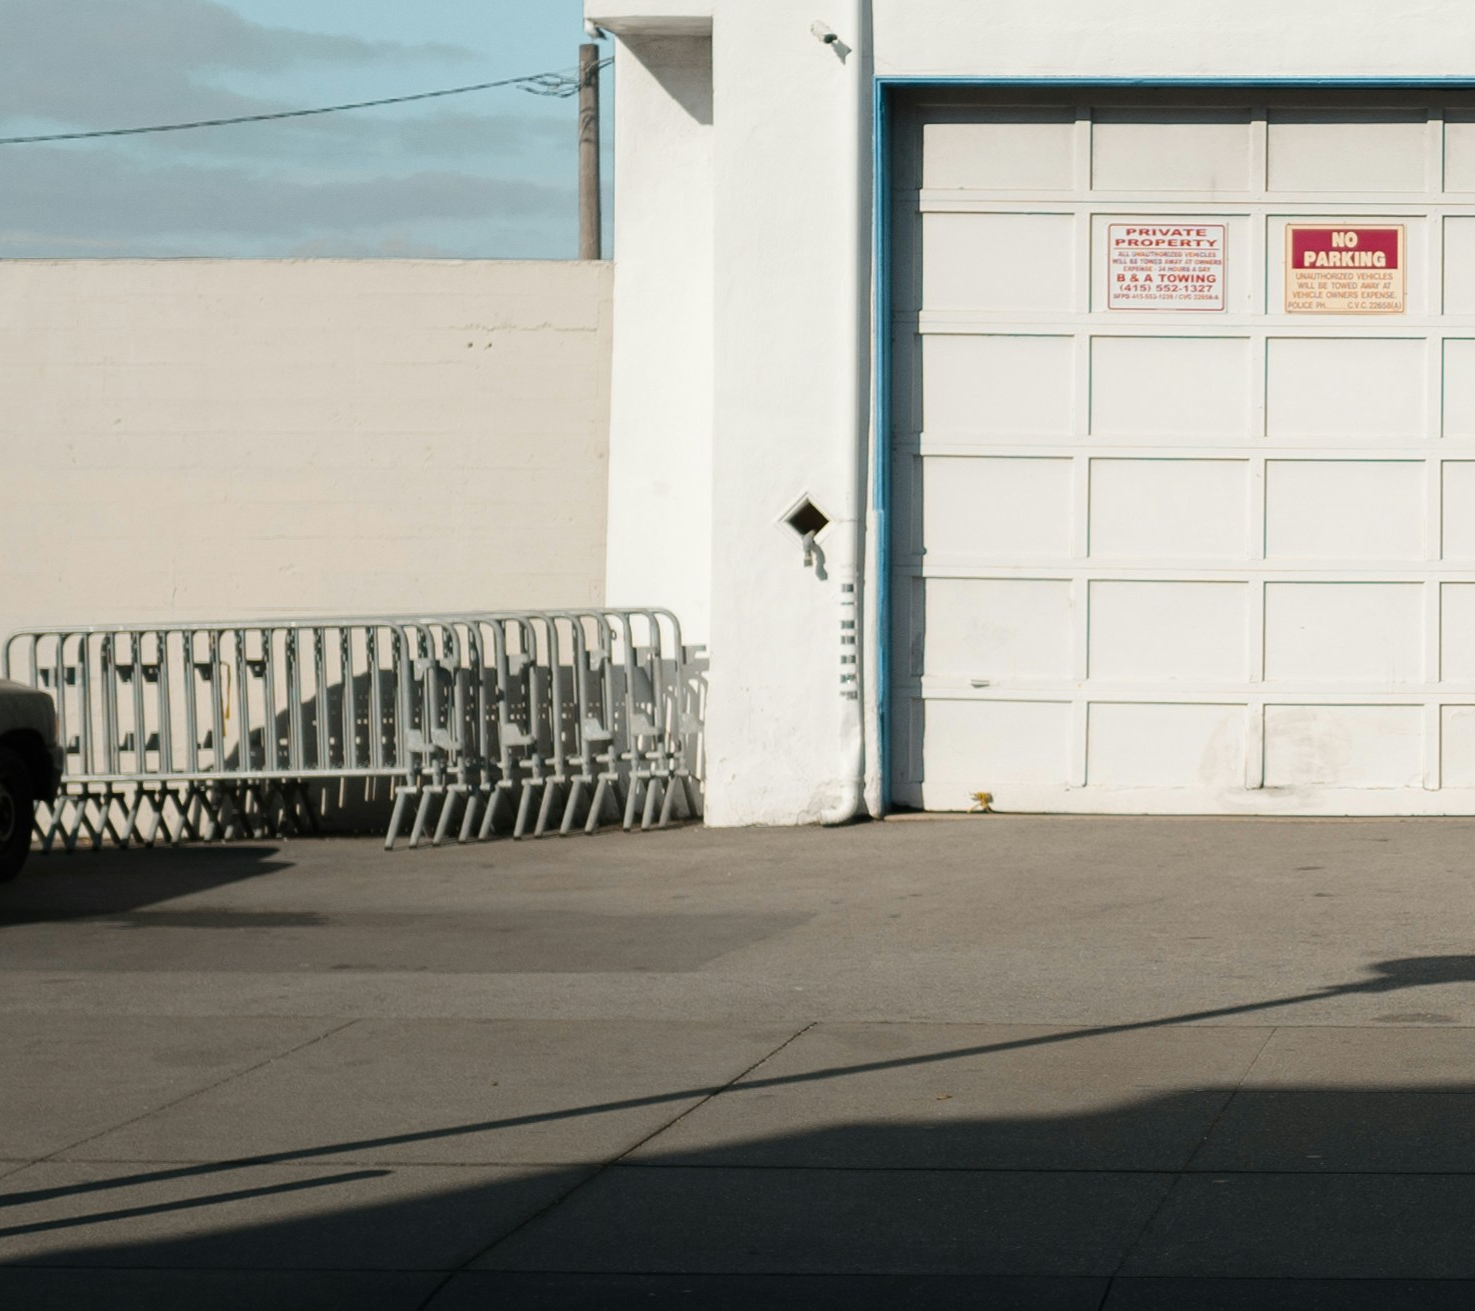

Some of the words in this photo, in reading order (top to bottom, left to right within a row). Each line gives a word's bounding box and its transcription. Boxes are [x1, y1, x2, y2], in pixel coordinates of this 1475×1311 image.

[1126, 228, 1207, 236] PRIVATE
[1114, 238, 1218, 247] PROPERTY
[1331, 231, 1358, 248] NO
[1304, 250, 1386, 268] PARKING
[1116, 274, 1126, 283] B
[1130, 274, 1139, 283] &
[1144, 274, 1153, 283] A
[1158, 274, 1216, 283] TOWING
[1295, 272, 1354, 280] UNAUTHORIZED
[1356, 272, 1394, 280] VEHICLES
[1119, 284, 1152, 292] (415)
[1156, 284, 1213, 292] 552-1327
[1296, 282, 1315, 290] WILL
[1318, 282, 1328, 290] BE
[1331, 282, 1358, 290] TOWED
[1360, 282, 1380, 290] AWAY
[1382, 282, 1392, 290] AT
[1292, 291, 1323, 299] VEHICLE
[1325, 291, 1358, 299] OWNERS
[1287, 301, 1313, 309] POLICE
